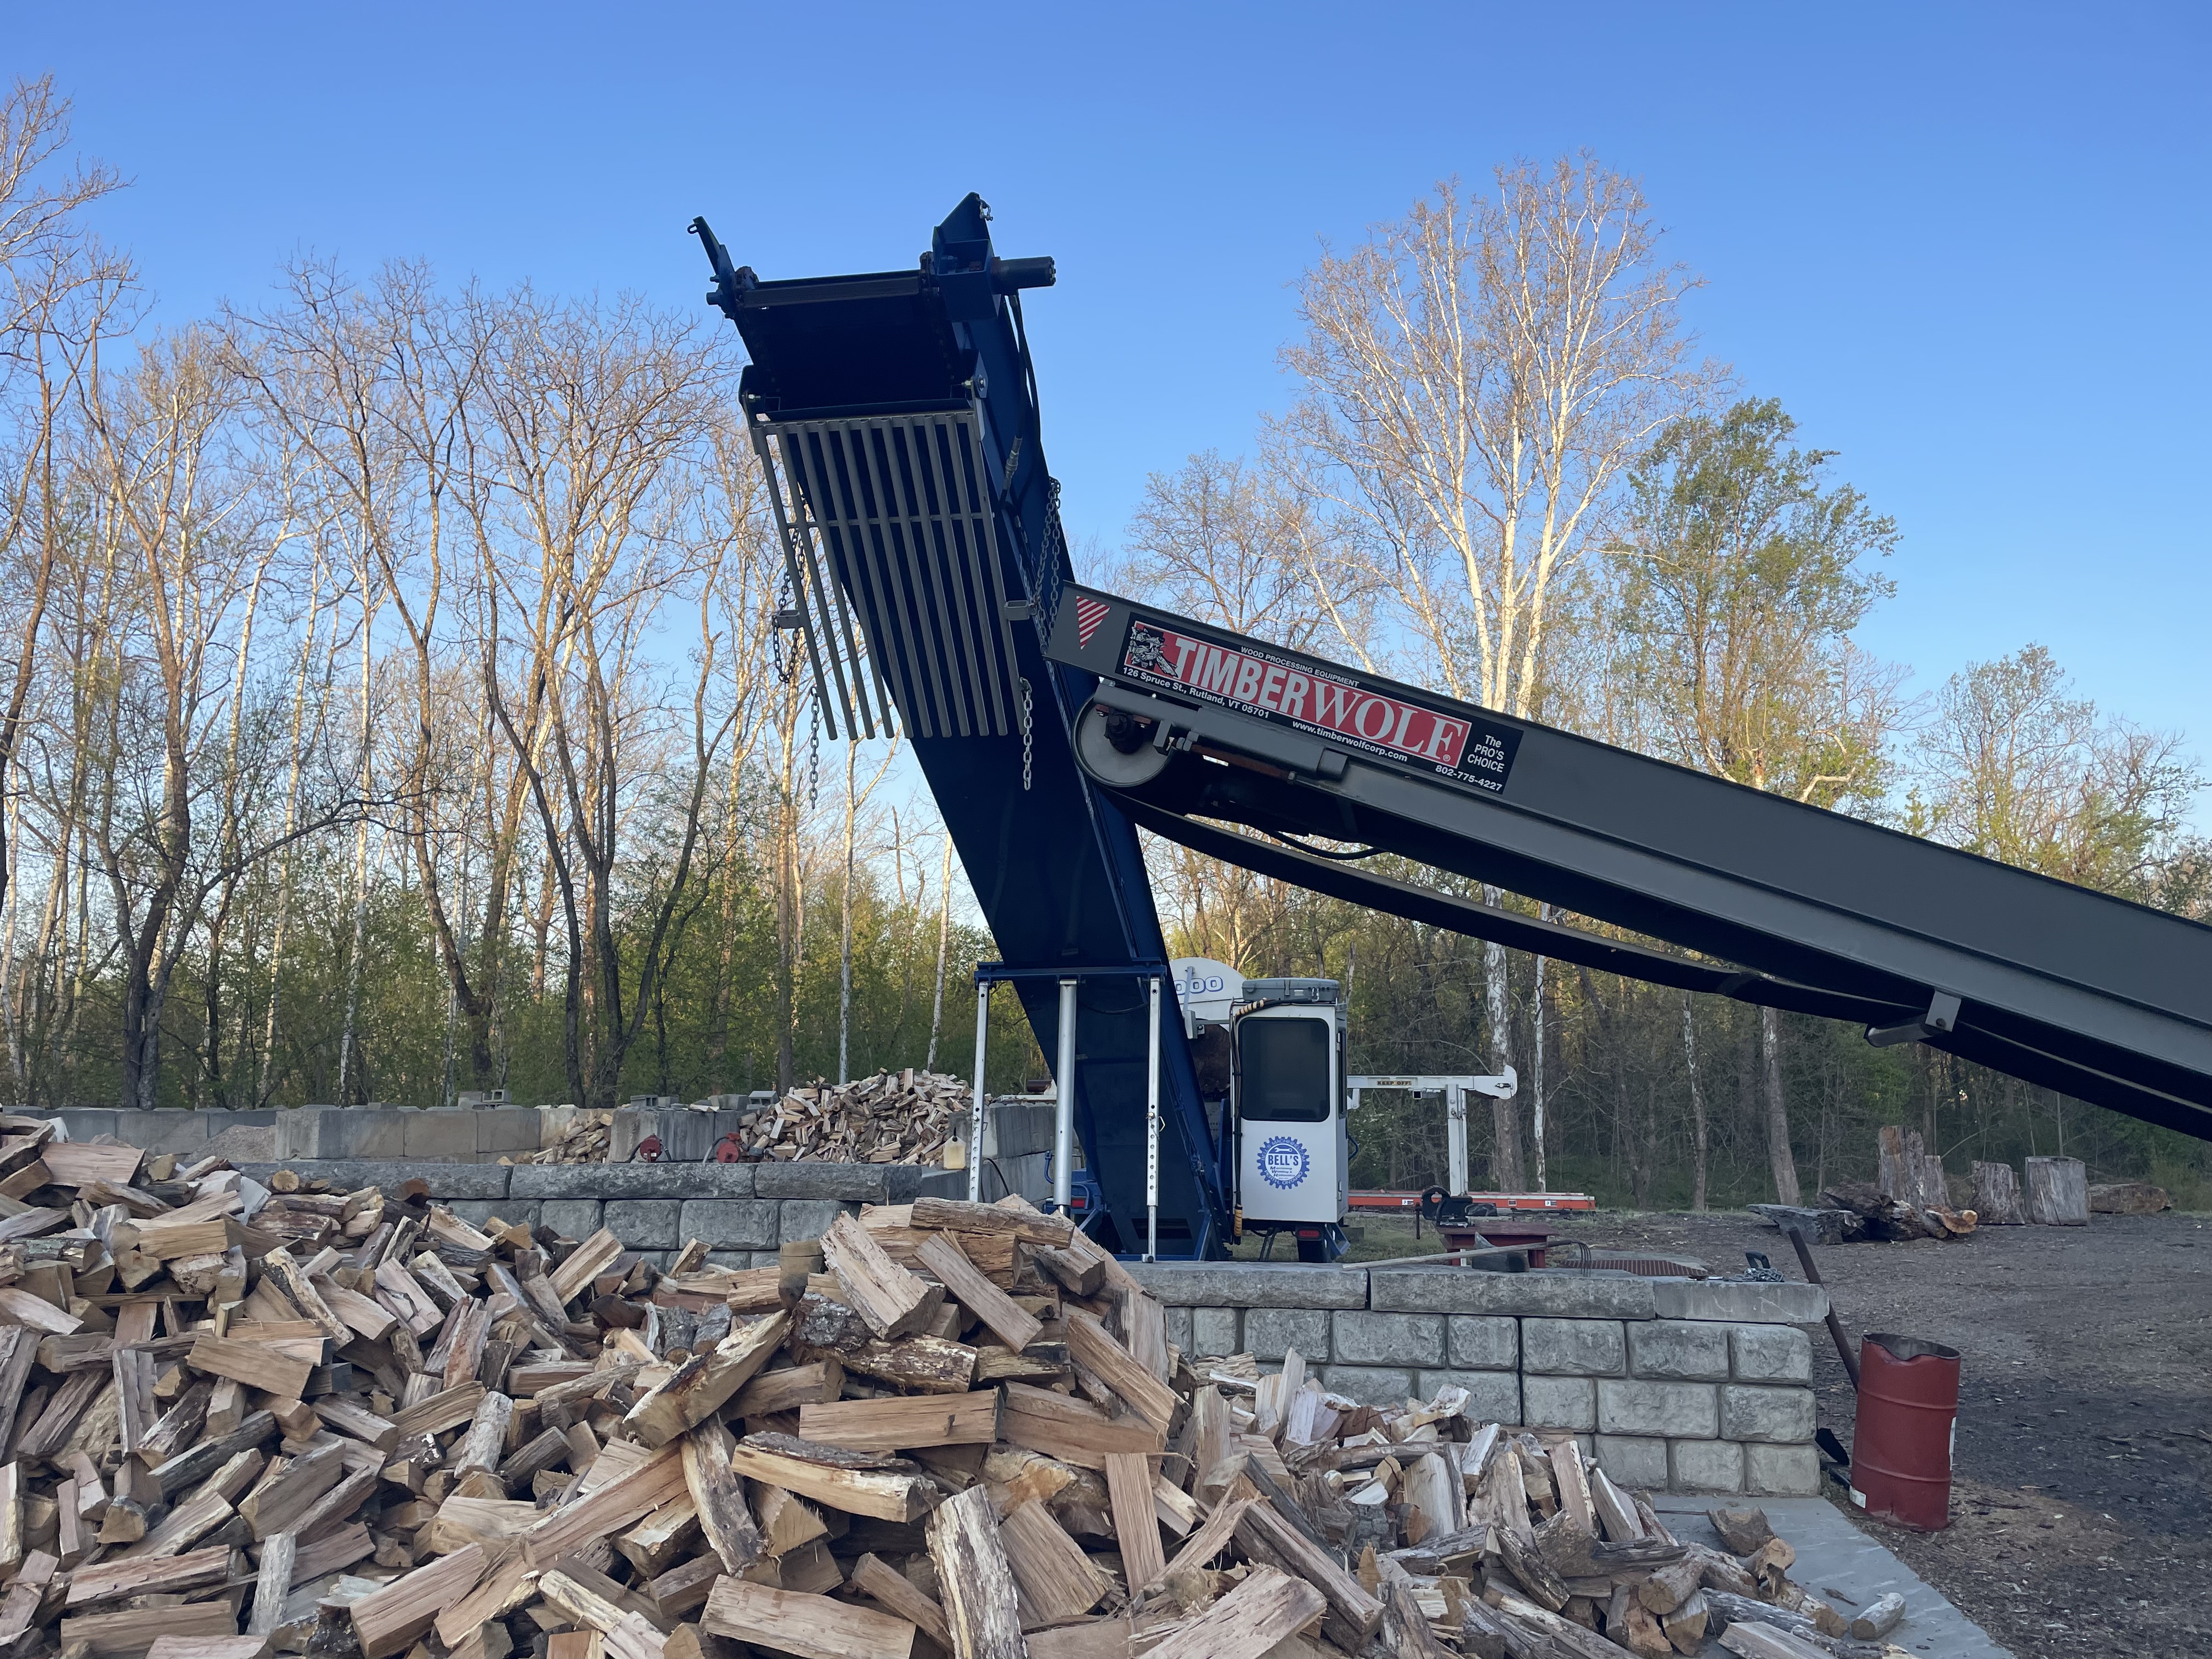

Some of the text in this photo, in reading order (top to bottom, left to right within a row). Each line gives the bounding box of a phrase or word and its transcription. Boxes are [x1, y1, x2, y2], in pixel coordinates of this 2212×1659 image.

[1241, 646, 1359, 687] WOOD PROCESSING EQUIPMENT
[1123, 667, 1269, 718] 126 Spruce St., Rutland, VT 05701
[1175, 637, 1464, 760] TIMBERWOLF
[1292, 720, 1408, 762] www.timberwolfcorp.com
[1474, 744, 1505, 761] PRO'S
[1485, 734, 1502, 748] The
[1467, 754, 1505, 773] CHOICE
[1435, 765, 1503, 791] 802-775-4227
[1268, 1155, 1299, 1166] BELL'S
